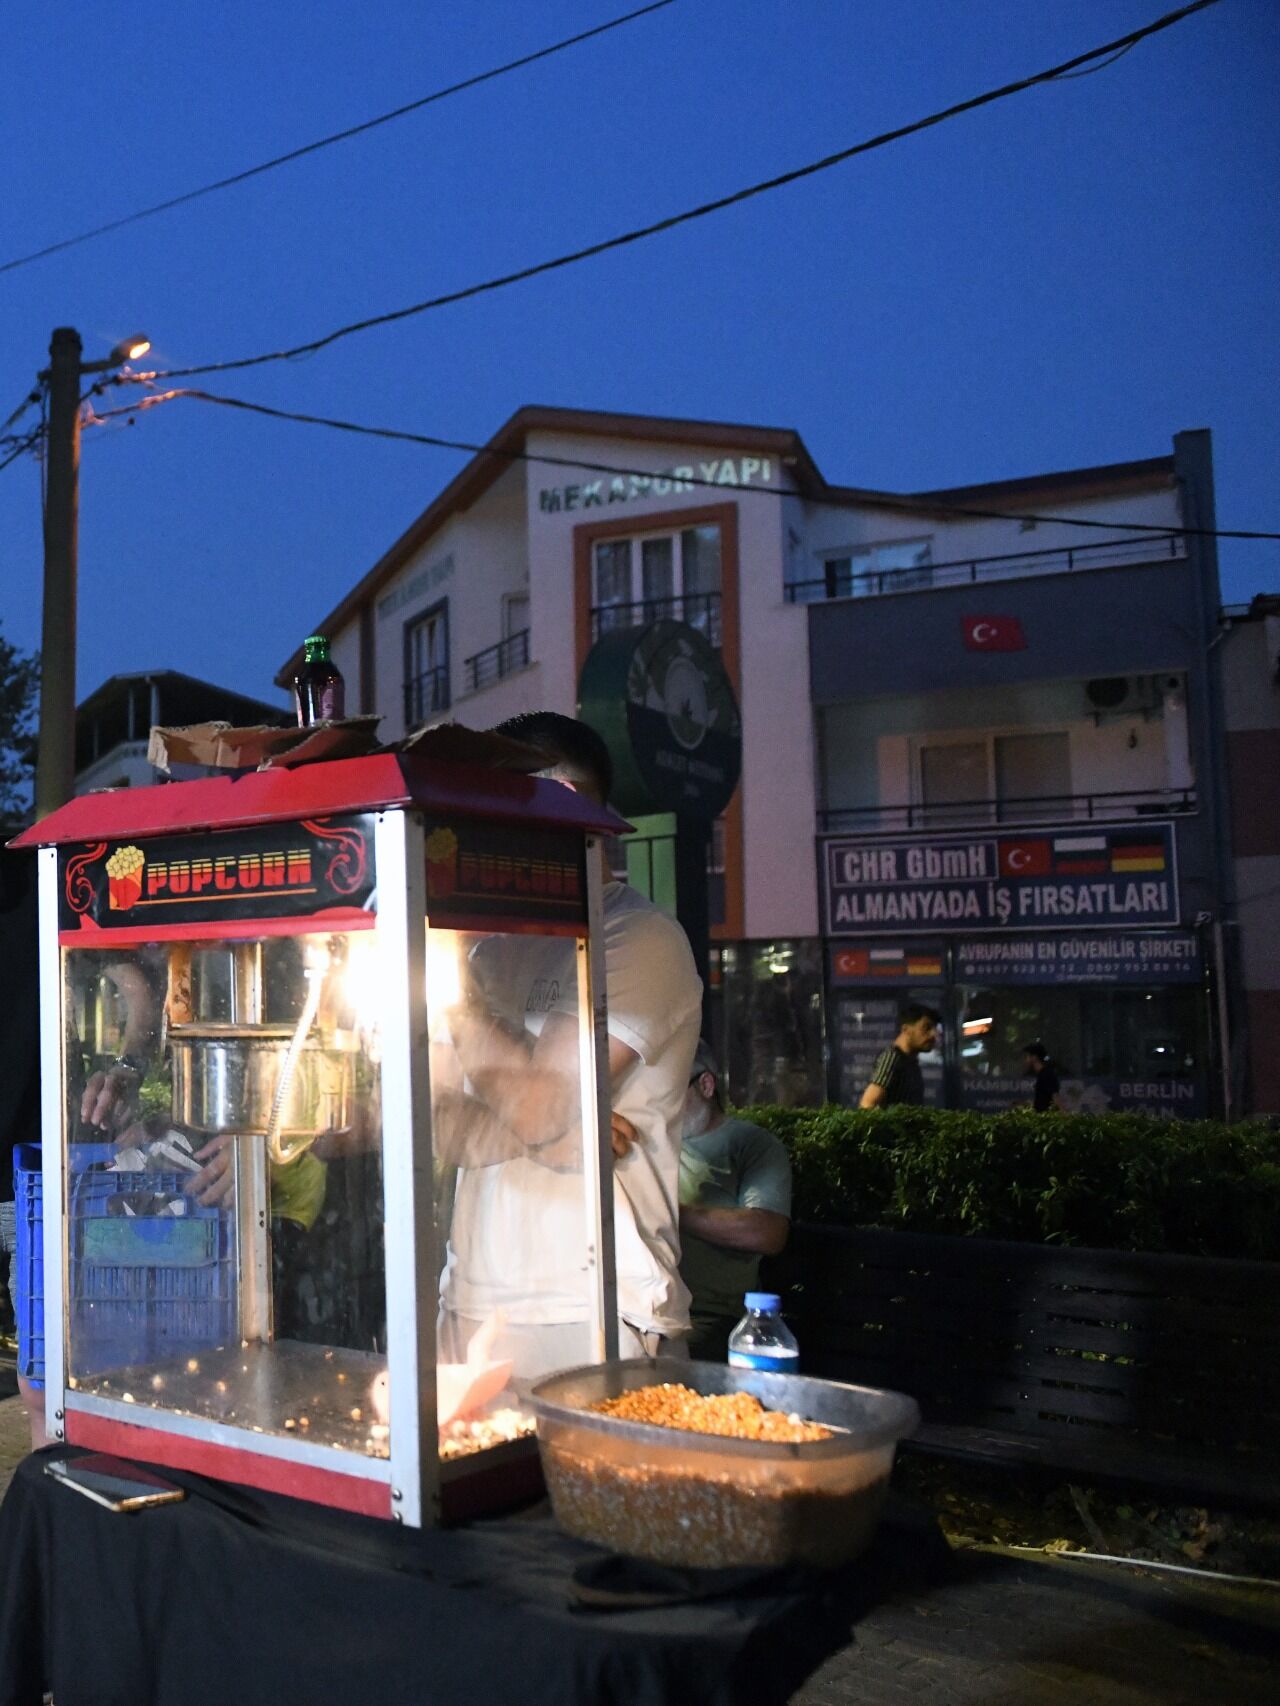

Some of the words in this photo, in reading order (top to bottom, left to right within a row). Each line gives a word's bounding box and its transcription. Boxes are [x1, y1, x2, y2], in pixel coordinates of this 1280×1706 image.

[698, 456, 770, 486] YAPI
[147, 848, 314, 896] POPCORN
[843, 851, 897, 882] CHR
[836, 888, 981, 923] ALMANYADA
[987, 882, 1013, 924] İŞ
[1019, 881, 1169, 917] FIRSATLARI
[959, 942, 1034, 960] AVRUPANIN
[1037, 941, 1057, 959] EN
[1060, 937, 1135, 959] GÜVENİLİR
[1139, 936, 1197, 961] ŞİRKETİ
[1119, 1079, 1194, 1099] BERLİN
